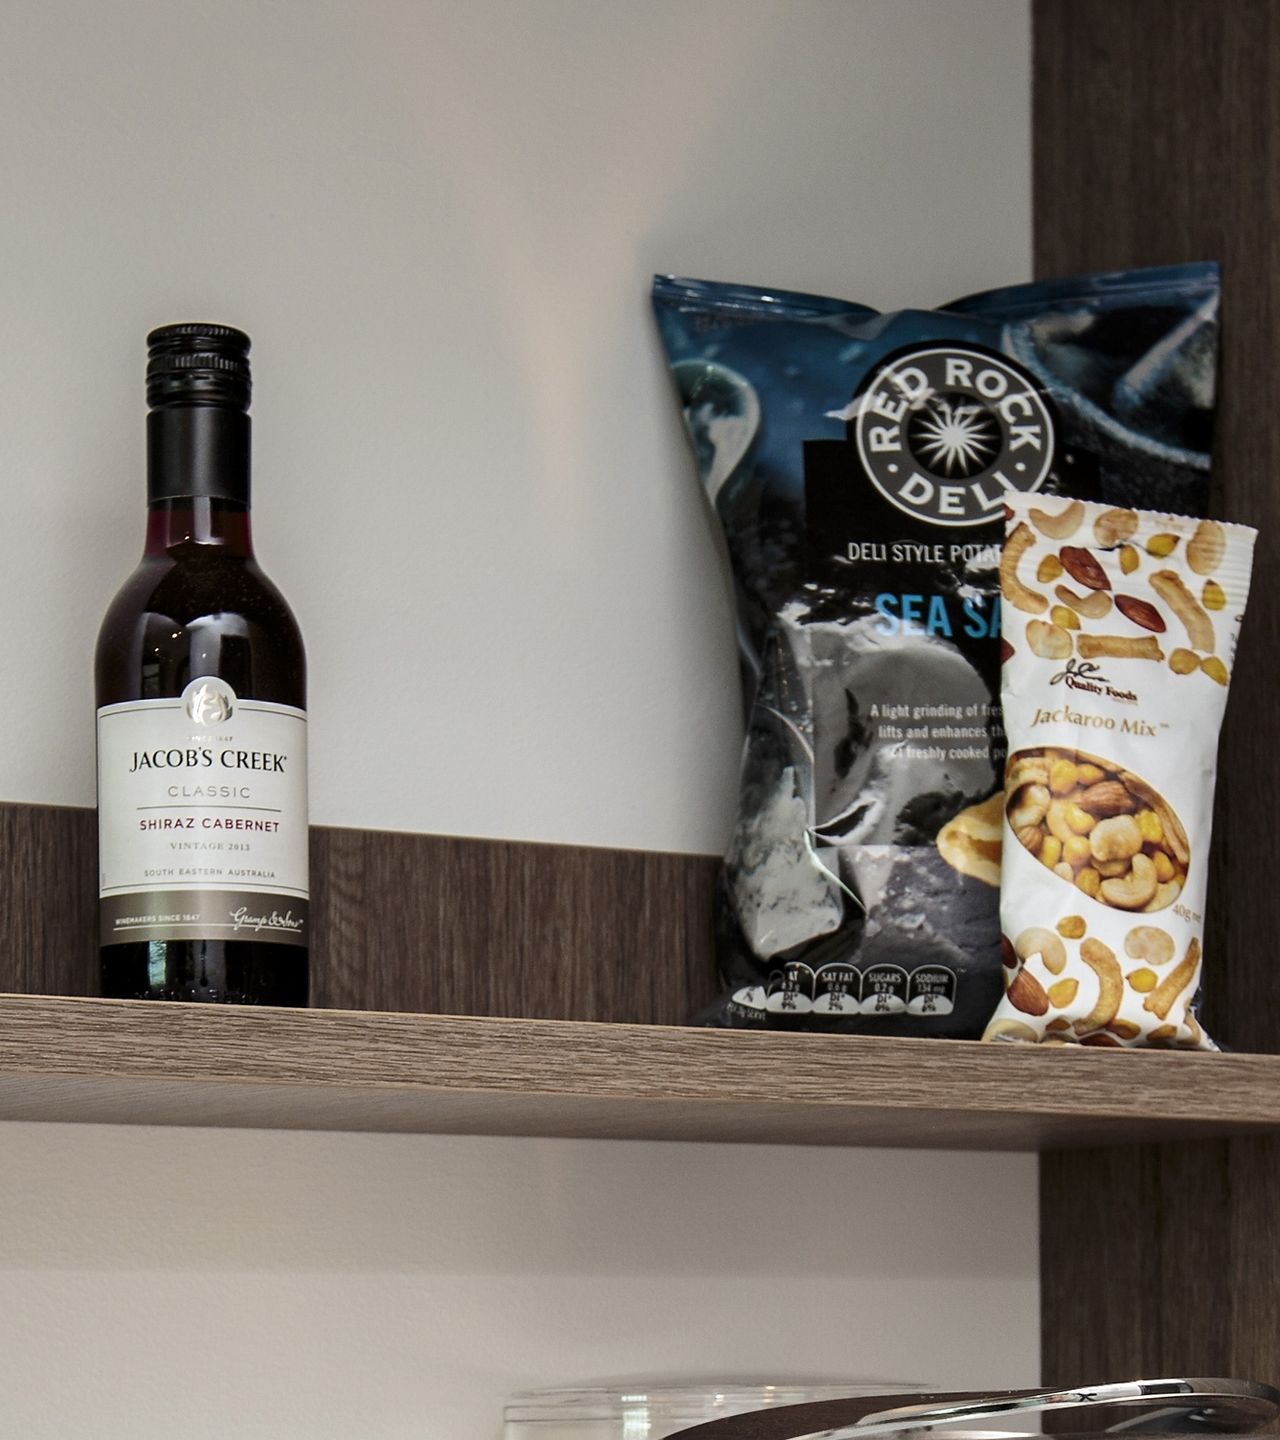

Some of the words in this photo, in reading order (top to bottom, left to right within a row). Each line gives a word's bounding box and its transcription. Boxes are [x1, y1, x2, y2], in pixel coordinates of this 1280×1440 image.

[869, 367, 929, 452] RED
[945, 358, 1041, 451] ROCK
[898, 471, 1020, 515] DELI
[848, 542, 886, 561] DELI
[892, 544, 944, 563] STYLE
[875, 592, 953, 637] SEA
[1065, 676, 1103, 696] Quality
[1106, 686, 1138, 701] Foods
[871, 704, 880, 717] A
[882, 703, 909, 720] light
[913, 703, 963, 720] grinding
[966, 703, 978, 717] of
[1030, 705, 1116, 730] Jackaroo
[878, 725, 903, 739] lifts
[906, 725, 928, 738] and
[932, 725, 988, 738] enhances
[129, 747, 213, 773] JACOB'S
[220, 750, 286, 773] CREEK
[907, 745, 946, 761] freshly
[949, 746, 989, 759] cooked
[167, 785, 251, 799] CLASSIC
[139, 818, 195, 831] SHIRAZ
[202, 818, 280, 833] CABERNET
[170, 842, 224, 851] VINTAGE
[144, 868, 174, 877] SOUTH
[179, 868, 223, 876] EASTERN
[228, 869, 276, 879] AUSTRALIA
[115, 915, 158, 925] WINEMAKERS
[159, 914, 181, 922] SINCE
[821, 972, 837, 982] SAT
[839, 972, 853, 982] FAT
[868, 973, 902, 983] SUGARS
